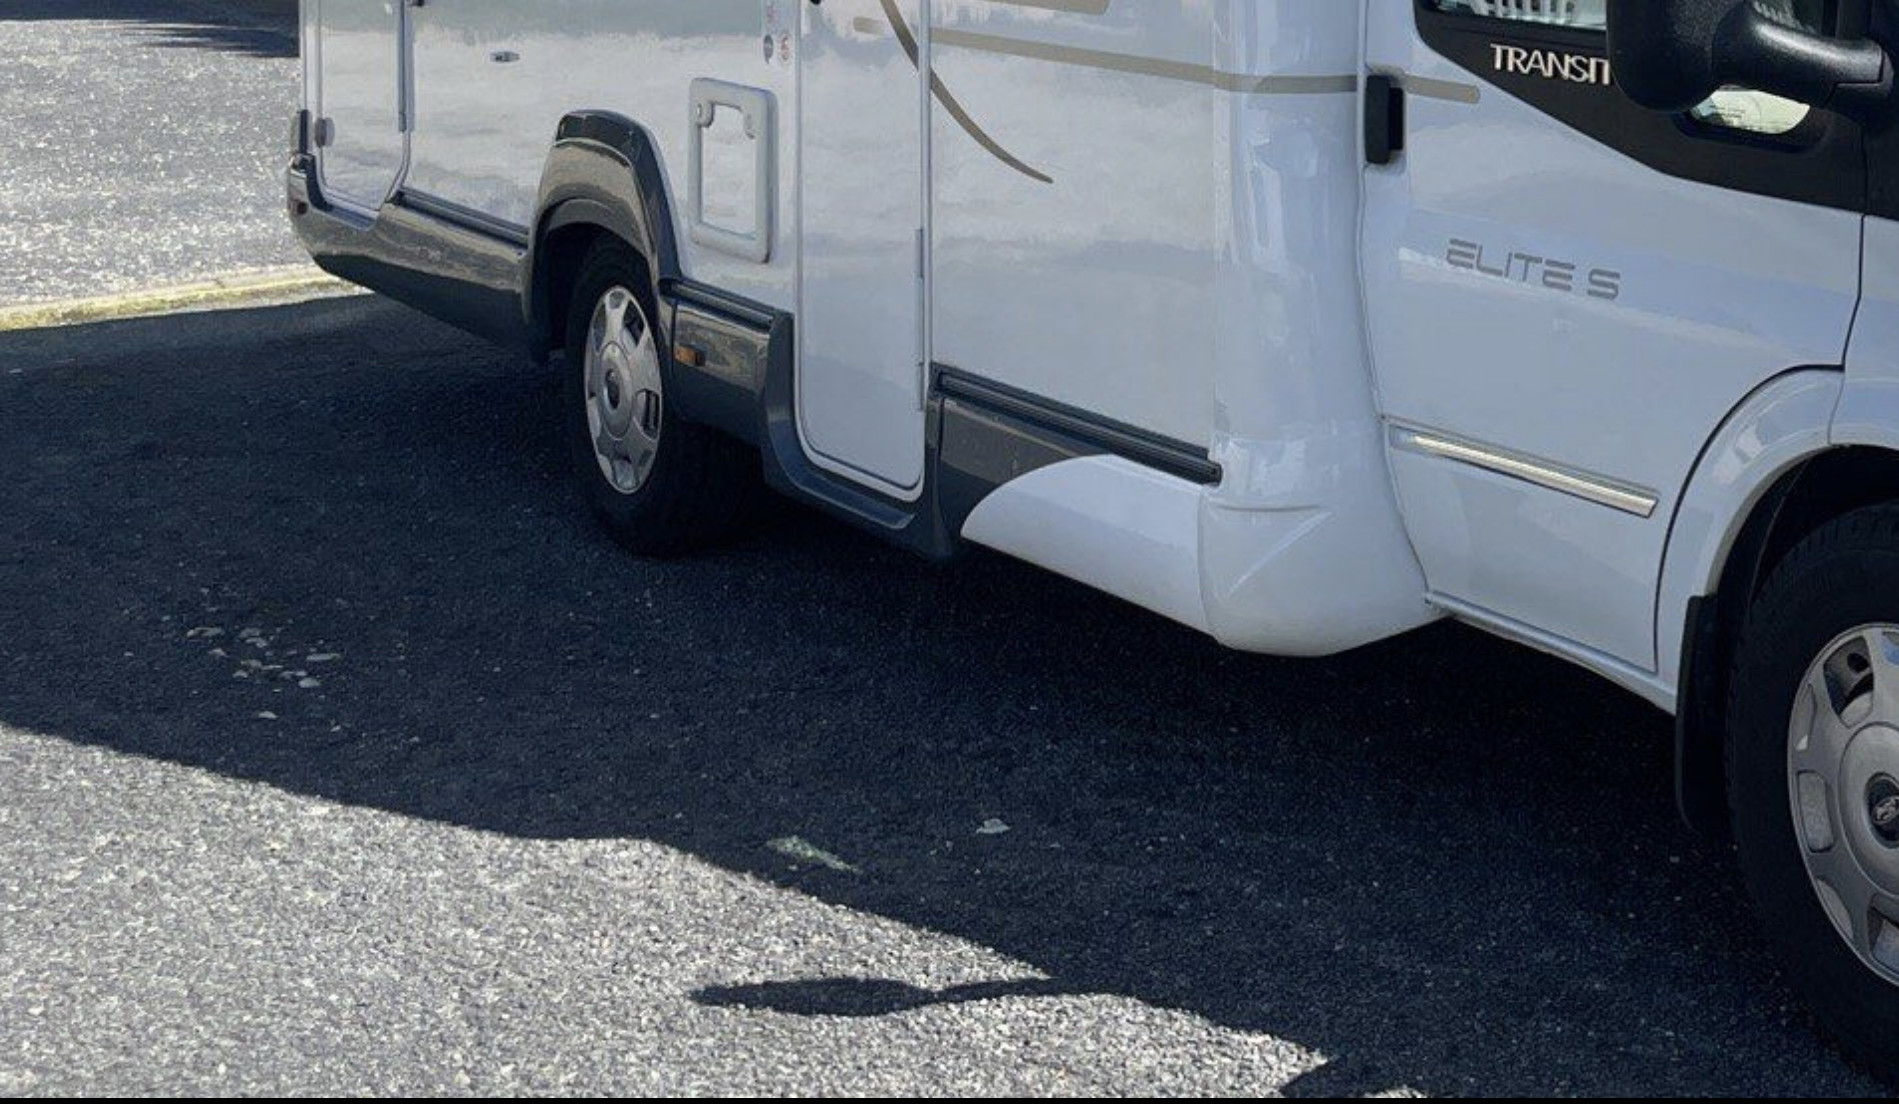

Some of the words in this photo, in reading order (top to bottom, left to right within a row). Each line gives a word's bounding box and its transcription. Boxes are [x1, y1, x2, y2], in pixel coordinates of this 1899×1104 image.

[1490, 43, 1611, 86] TRANSIT
[1446, 238, 1576, 292] ELITE
[1587, 268, 1621, 300] S
